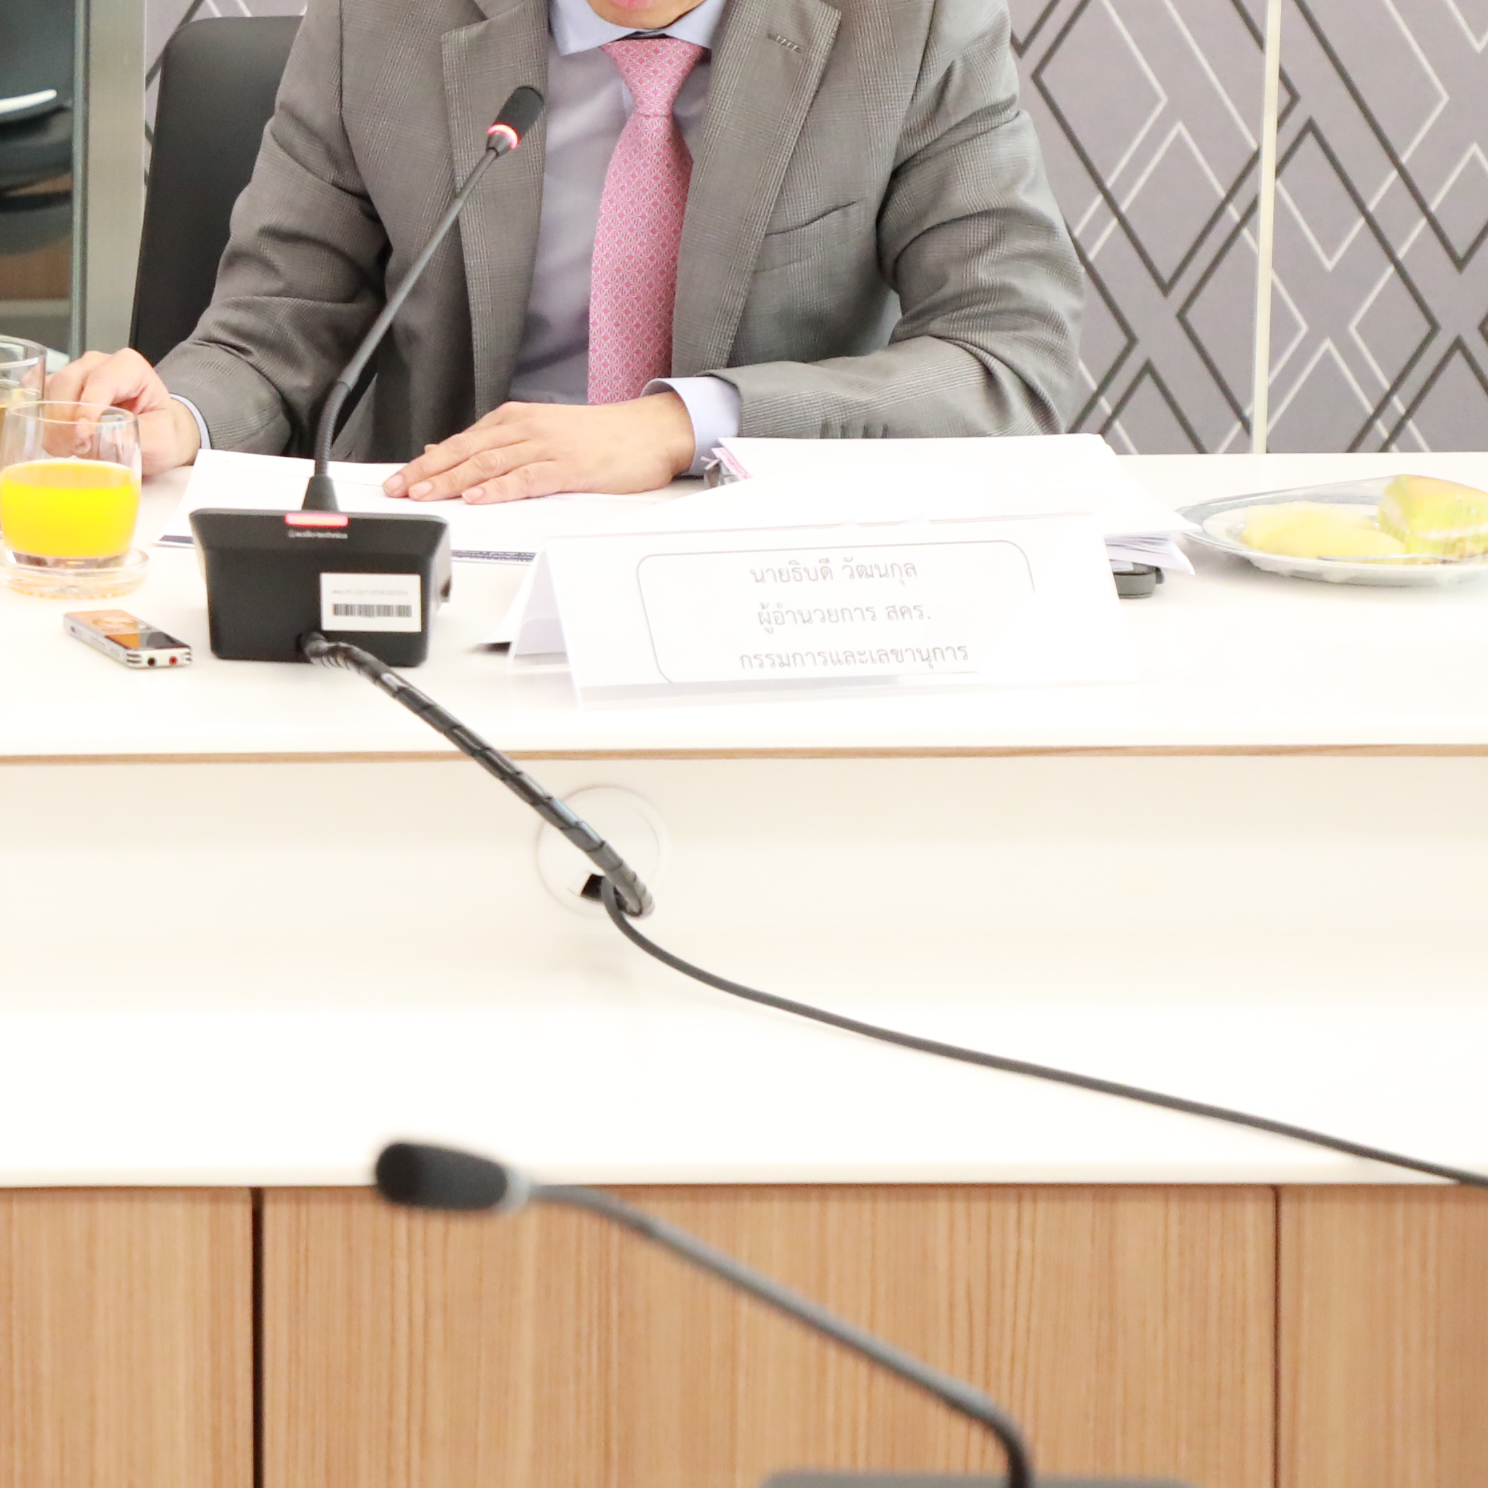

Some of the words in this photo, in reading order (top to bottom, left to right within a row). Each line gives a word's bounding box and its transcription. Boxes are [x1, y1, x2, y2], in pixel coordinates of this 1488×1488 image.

[749, 557, 834, 585] นายธิบดี
[841, 556, 918, 586] วัฒนกุล
[756, 601, 877, 635] ผู้อำนวยการ
[885, 603, 932, 623] สคร.
[738, 643, 970, 671] กรรมการและเลขานุการ
